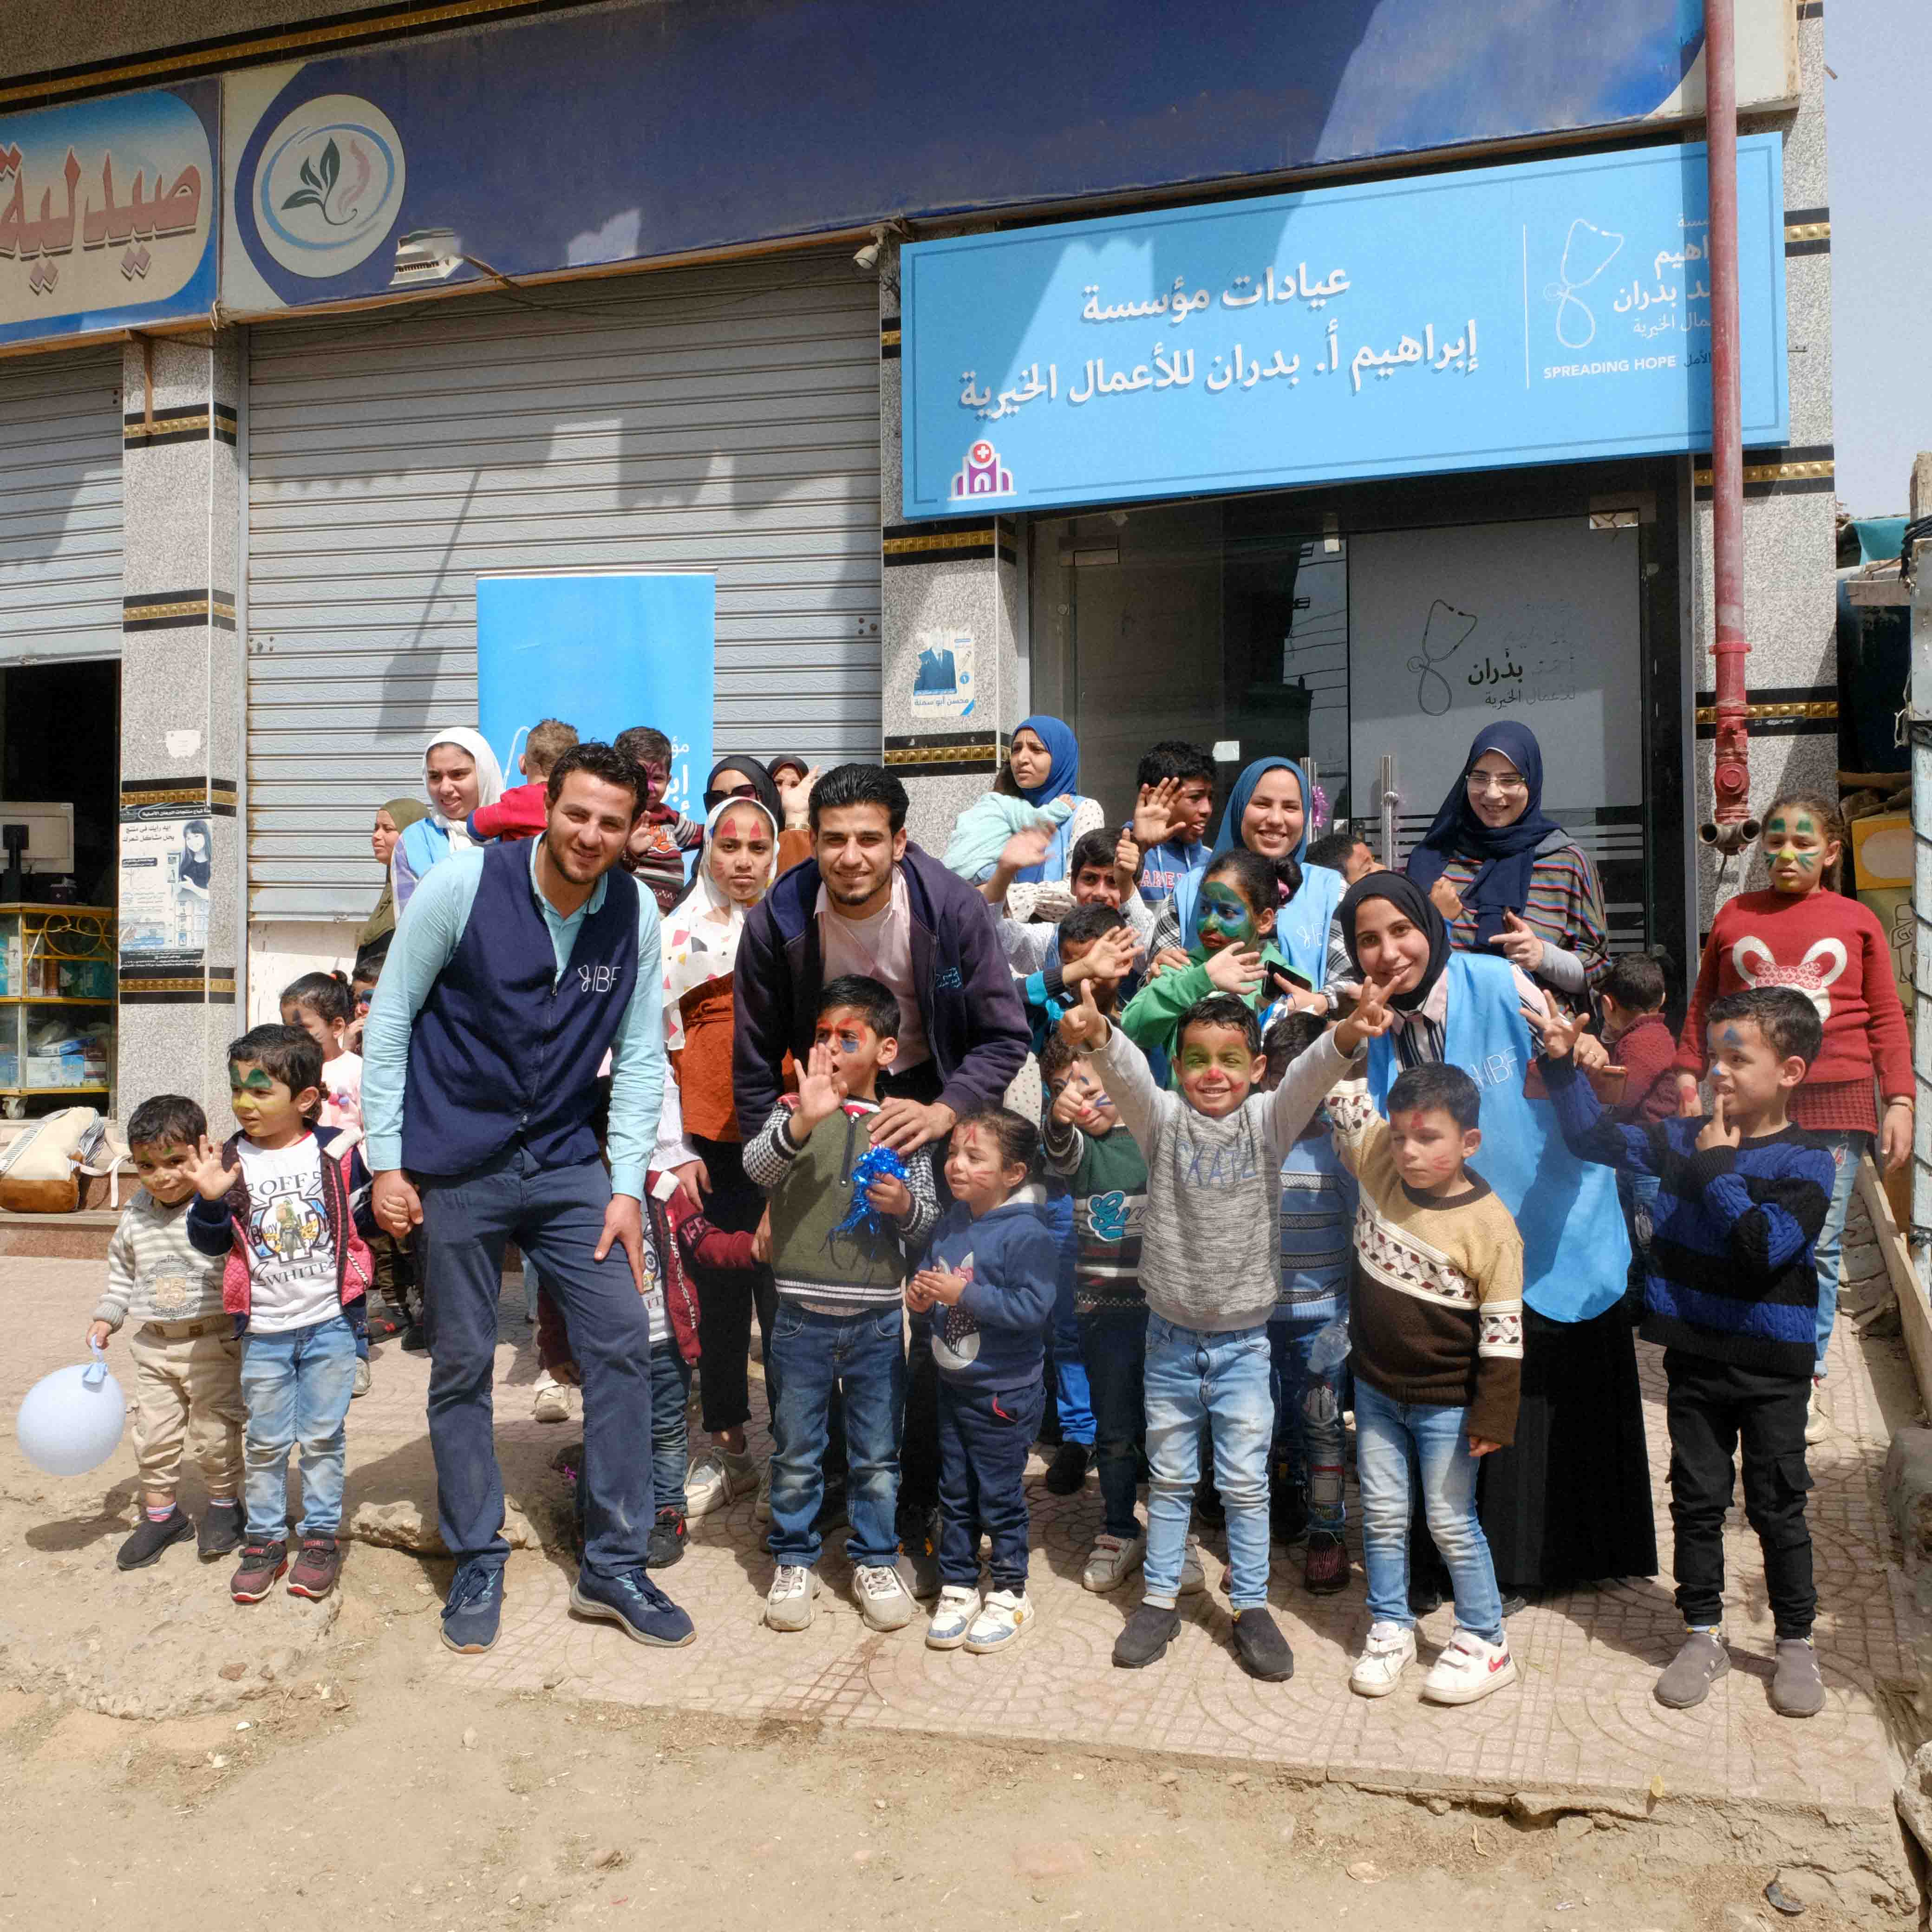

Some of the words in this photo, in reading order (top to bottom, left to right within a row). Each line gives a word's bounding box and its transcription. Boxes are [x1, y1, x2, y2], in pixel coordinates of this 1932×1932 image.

[0, 141, 202, 295] صيدلية
[1654, 235, 1710, 280] اهيم
[1083, 275, 1210, 323] مؤسسة
[1222, 261, 1351, 307] عيادات
[1613, 280, 1677, 312] بدران
[1634, 313, 1675, 339] الخيرية
[1070, 342, 1194, 403] للأعمال
[1207, 345, 1300, 390] بدران
[1351, 319, 1479, 392] إبراهيم
[1544, 359, 1629, 379] SPREADING
[1634, 355, 1677, 370] HOPE
[960, 363, 1057, 419] الخيرية
[1140, 869, 1182, 888] AKE
